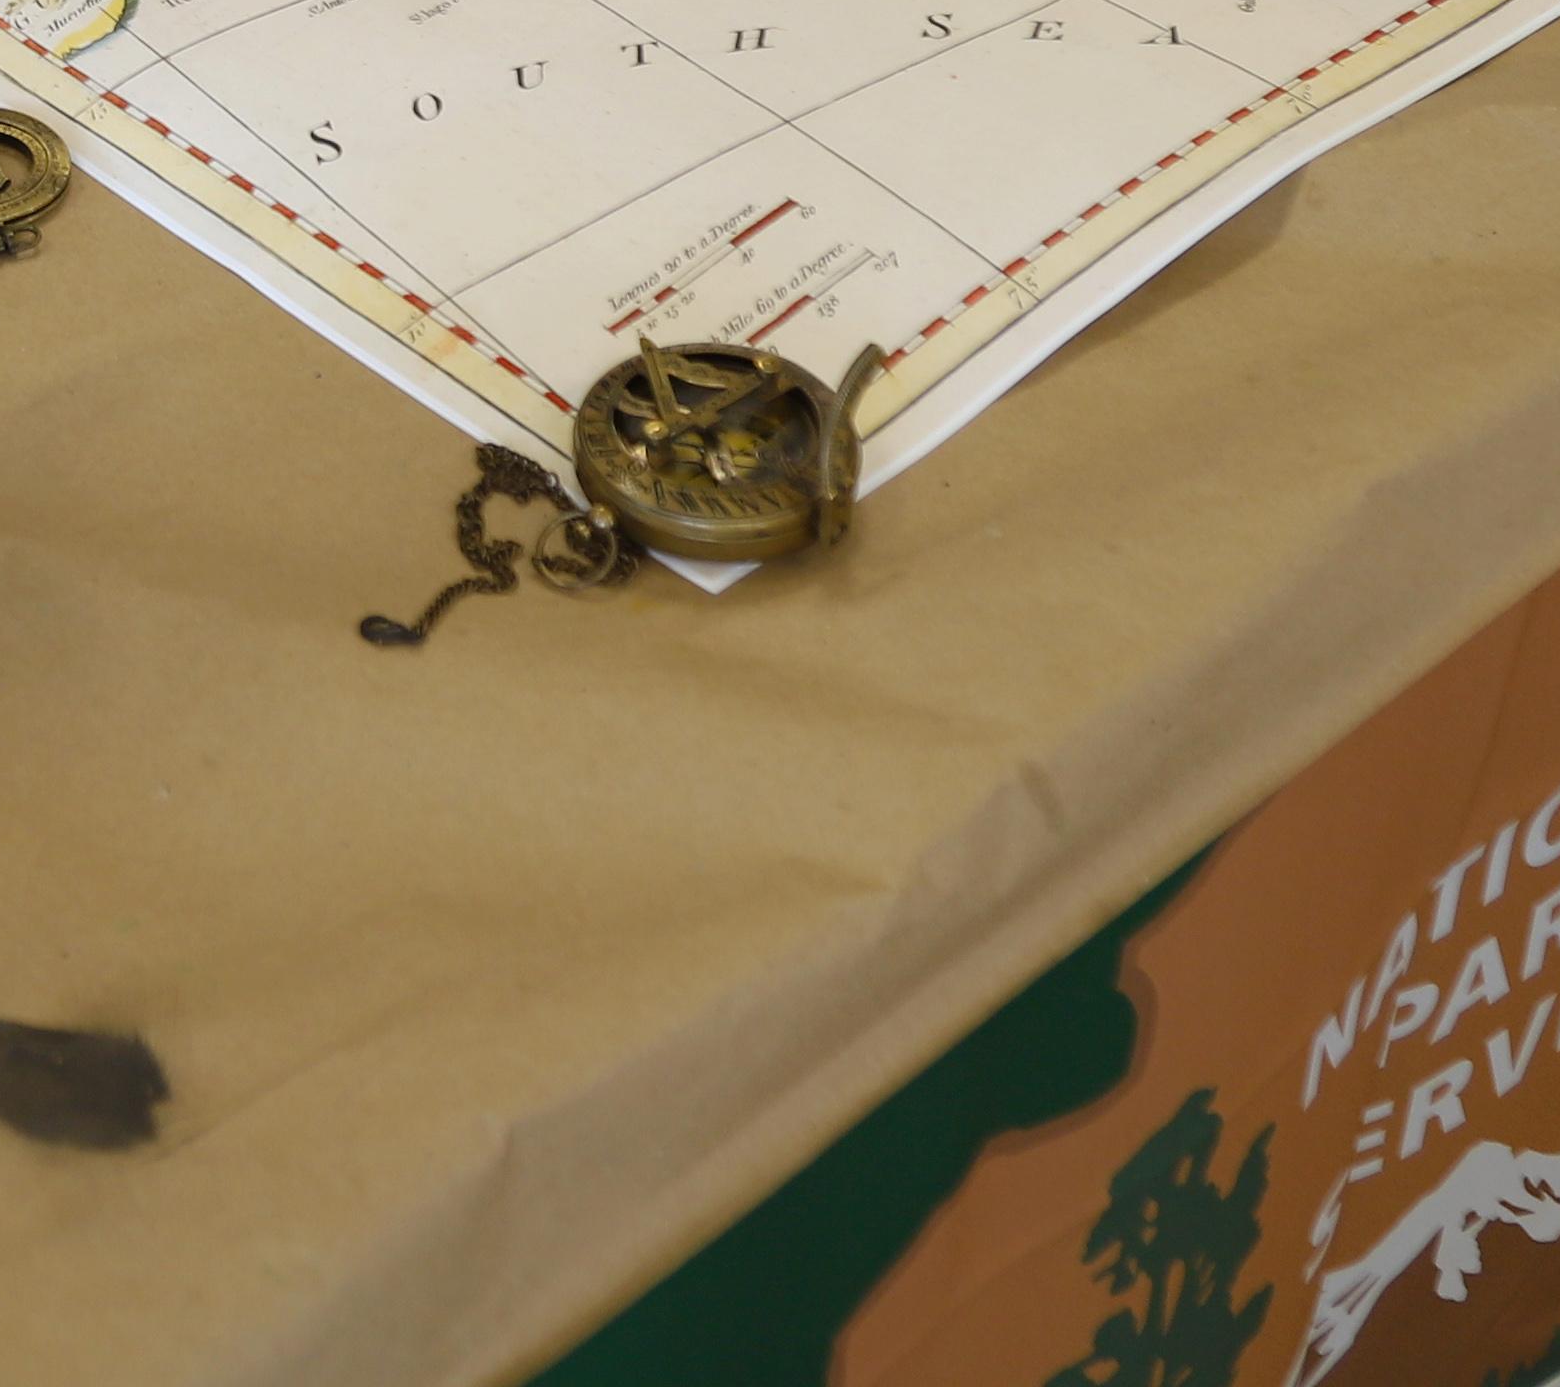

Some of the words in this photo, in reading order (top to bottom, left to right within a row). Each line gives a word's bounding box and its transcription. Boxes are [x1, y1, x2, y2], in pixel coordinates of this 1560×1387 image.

[310, 26, 779, 167] SOUTH
[607, 271, 662, 312] Leagues
[664, 255, 682, 272] 20
[683, 245, 697, 259] to
[817, 295, 842, 318] 138
[719, 314, 754, 346] Miles
[756, 296, 775, 316] 69
[777, 283, 790, 300] to
